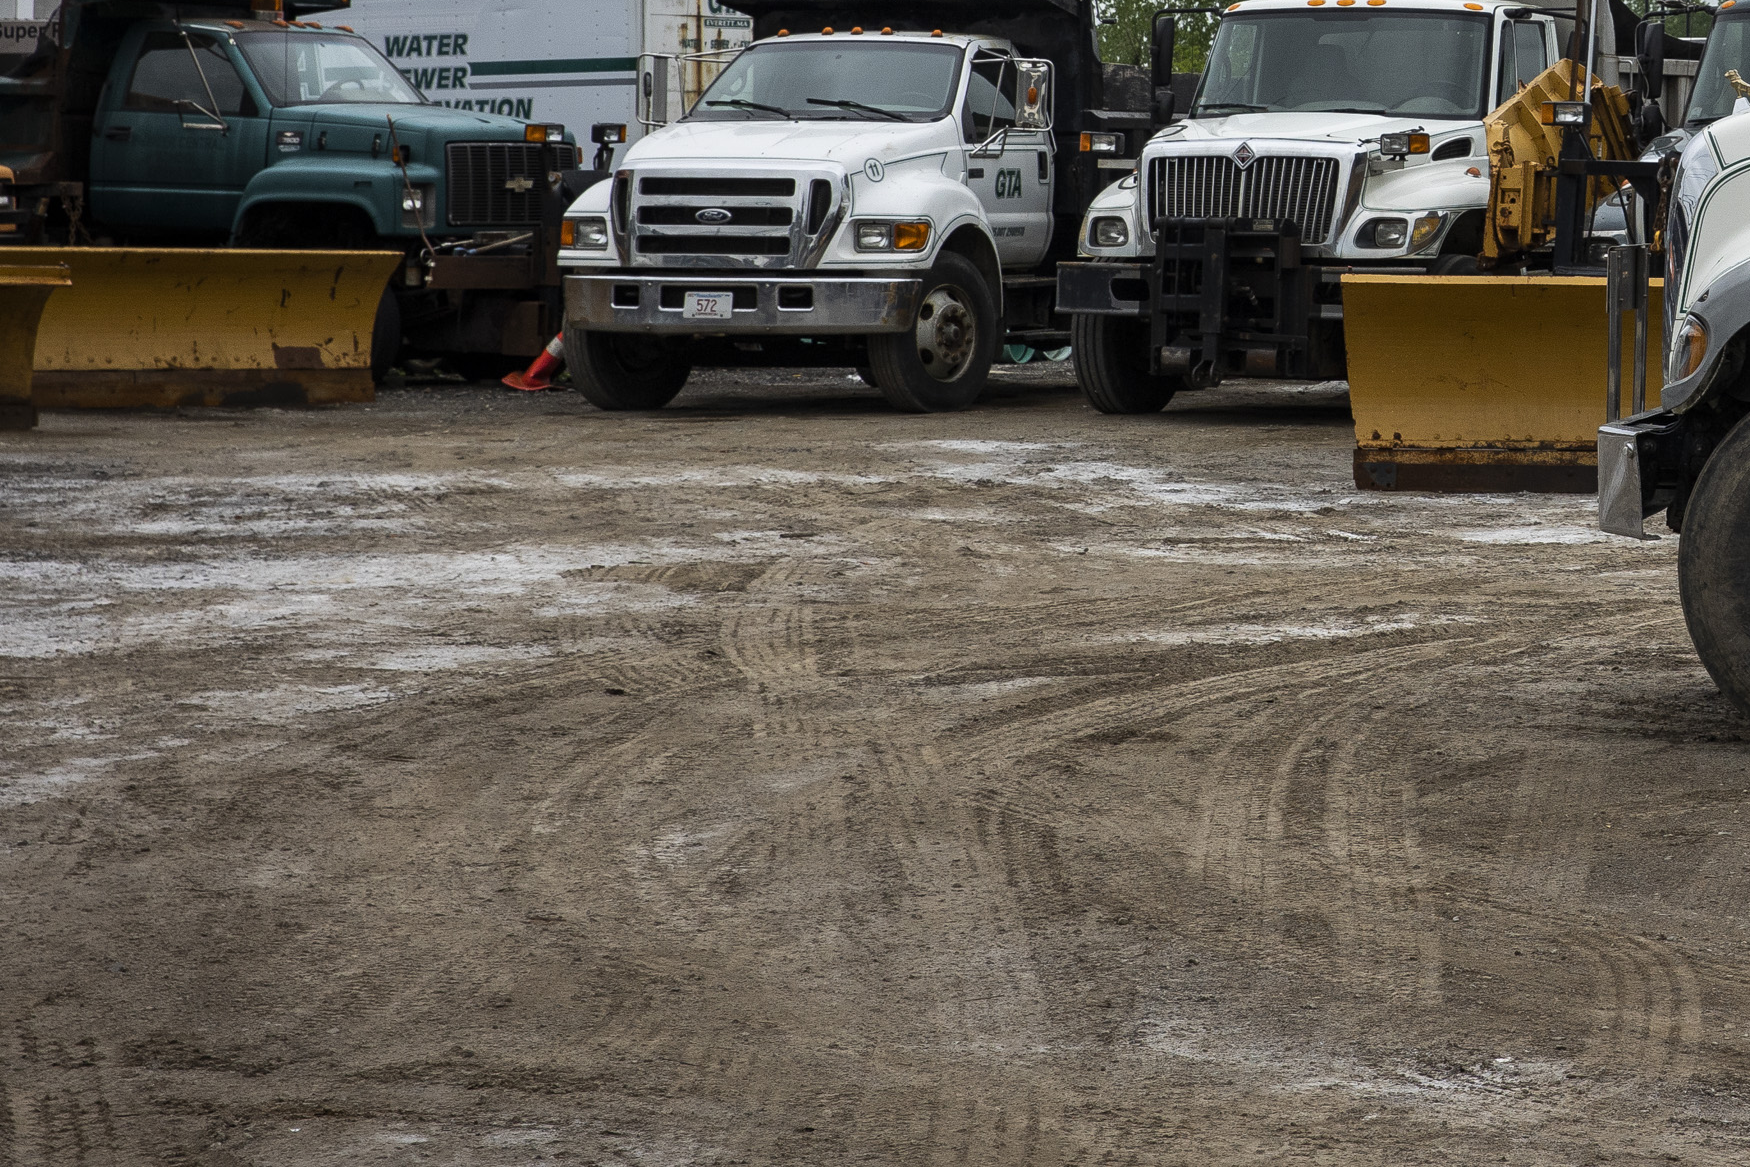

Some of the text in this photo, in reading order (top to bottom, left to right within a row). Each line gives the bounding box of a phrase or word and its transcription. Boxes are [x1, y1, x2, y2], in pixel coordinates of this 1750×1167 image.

[384, 34, 468, 57] WATER
[868, 163, 880, 177] 11
[994, 168, 1023, 199] GTA
[696, 298, 718, 313] 572
